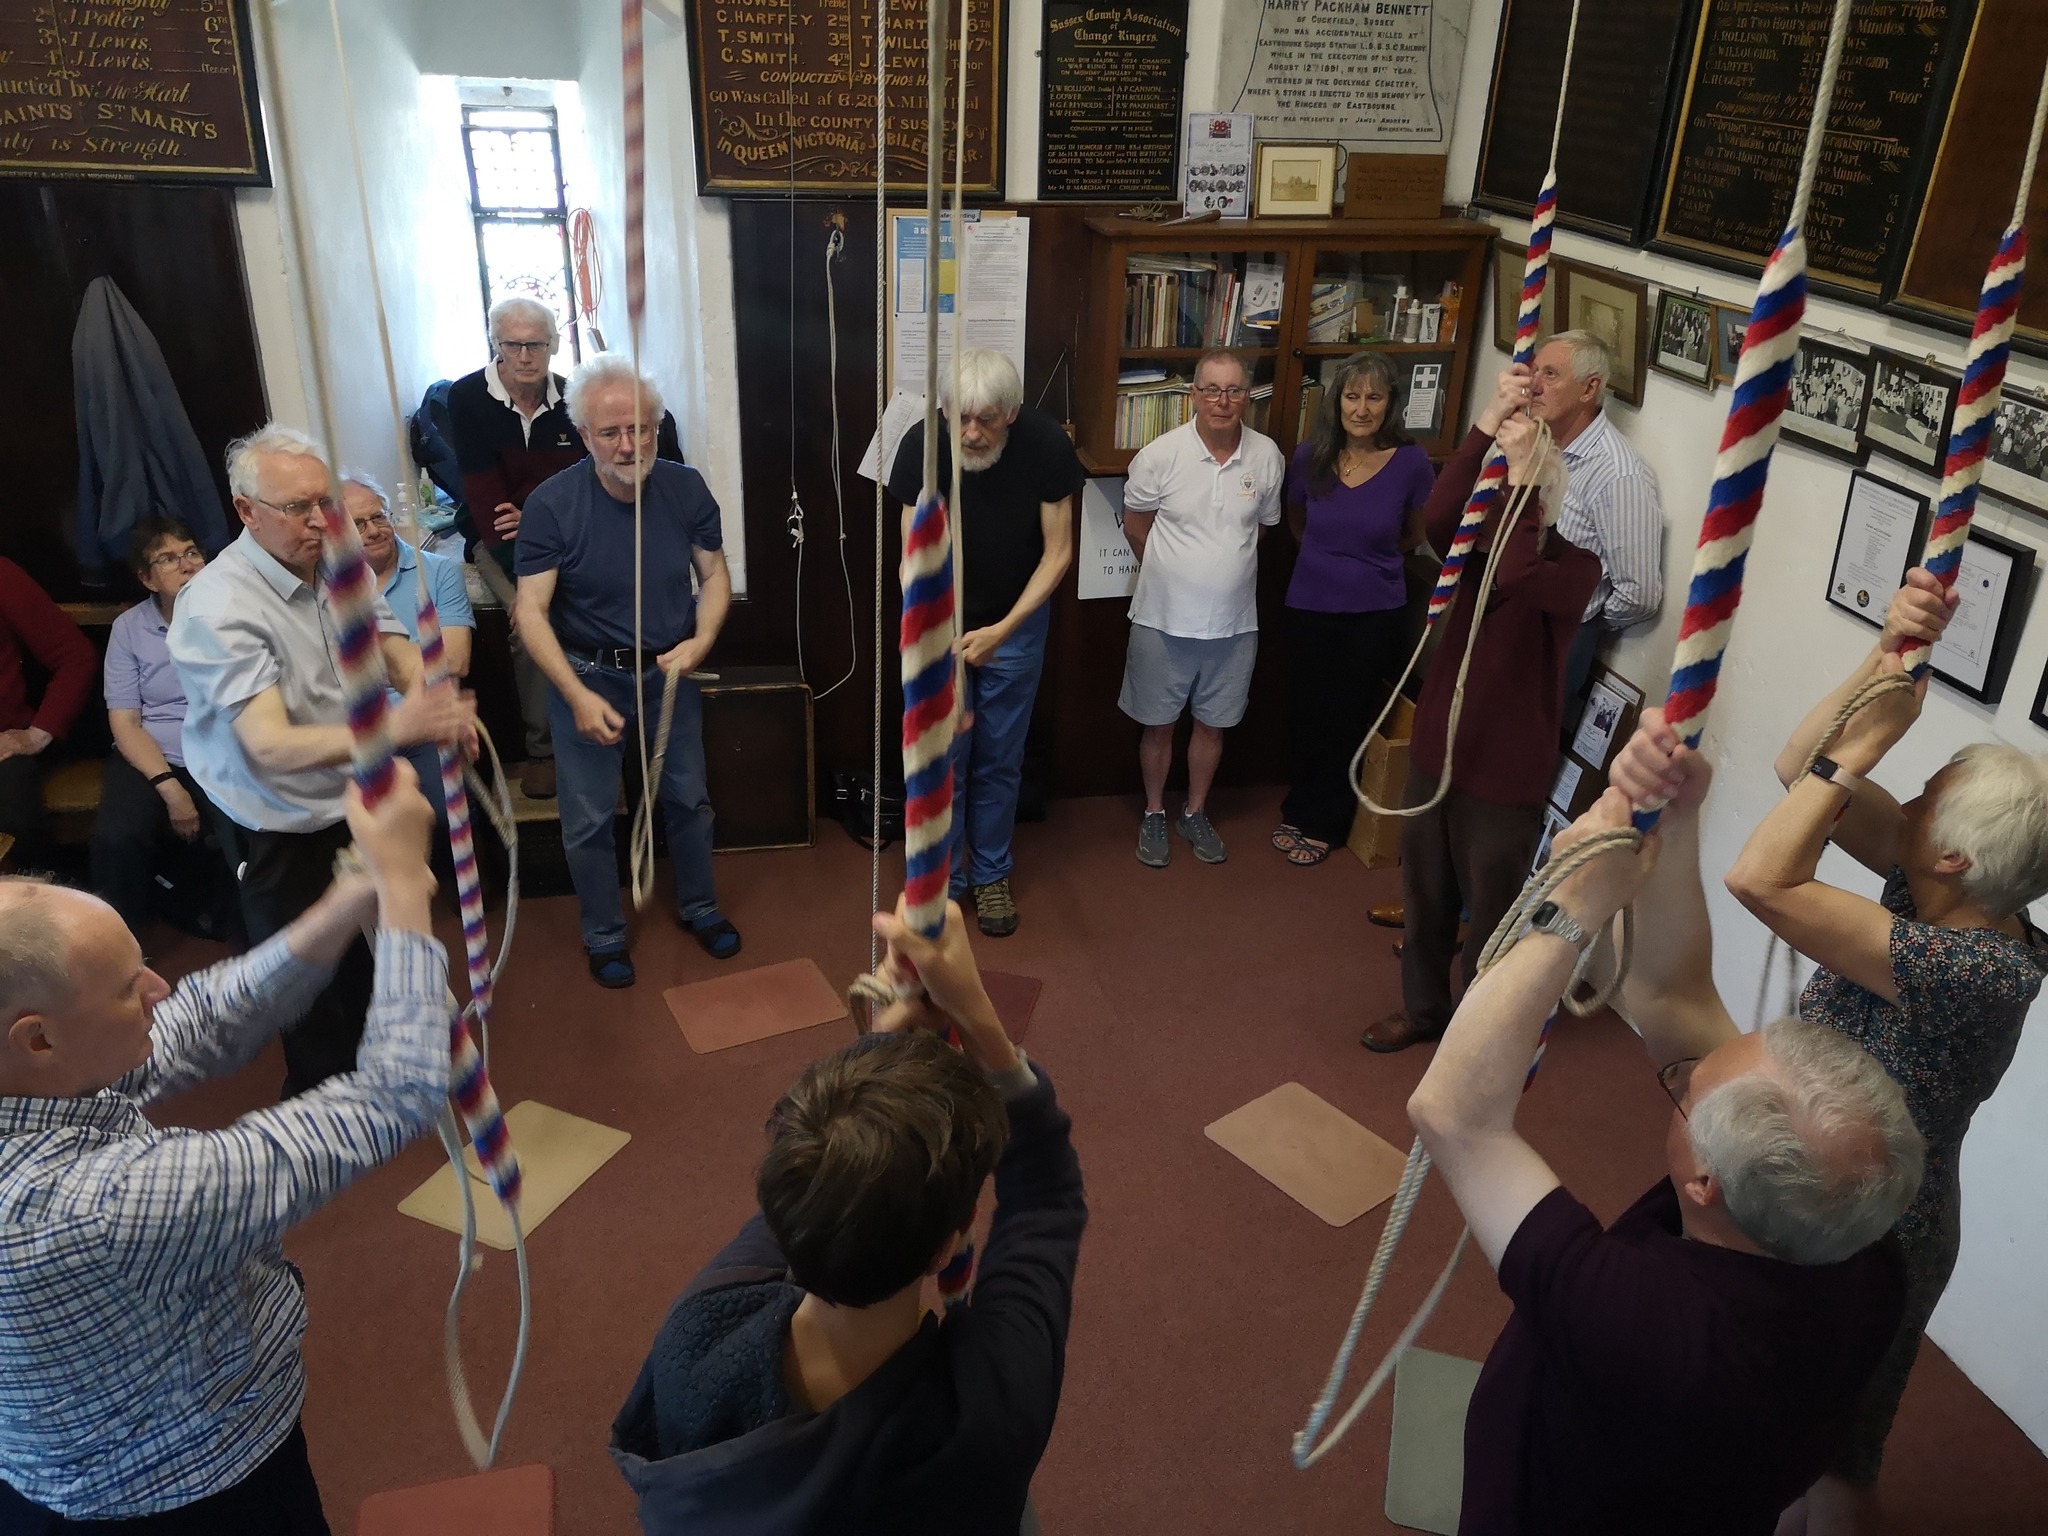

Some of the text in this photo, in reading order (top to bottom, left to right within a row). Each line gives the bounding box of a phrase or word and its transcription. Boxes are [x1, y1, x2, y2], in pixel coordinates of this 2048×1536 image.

[1314, 0, 1370, 14] PACKHAM
[1375, 3, 1431, 16] BENNETT
[1049, 8, 1181, 37] Sussex County Association
[1110, 22, 1118, 30] of
[1073, 28, 1113, 44] Change
[1315, 29, 1374, 38] ACCIDENTALLY
[1376, 31, 1403, 39] KILLED
[1408, 32, 1418, 40] AT
[1270, 51, 1293, 59] WHILE
[1310, 52, 1324, 60] THE
[1327, 53, 1368, 61] EXECUTION
[1267, 63, 1300, 72] AUGUST
[760, 70, 839, 84] CONDUCTED
[1316, 78, 1329, 86] THE
[730, 90, 761, 103] Was
[763, 90, 809, 105] Called
[1247, 88, 1271, 96] WHERE
[1355, 91, 1365, 99] TO
[1346, 102, 1396, 111] EASTBOURNE
[0, 103, 73, 125] AINTS
[131, 106, 218, 139] MARY'S
[755, 111, 959, 131] In the COUNTY SUSEX
[51, 137, 187, 160] is Strength.
[733, 140, 789, 166] QUEEN
[868, 133, 929, 156] JBILEE
[1112, 549, 1130, 557] CAN
[1103, 566, 1113, 575] TO
